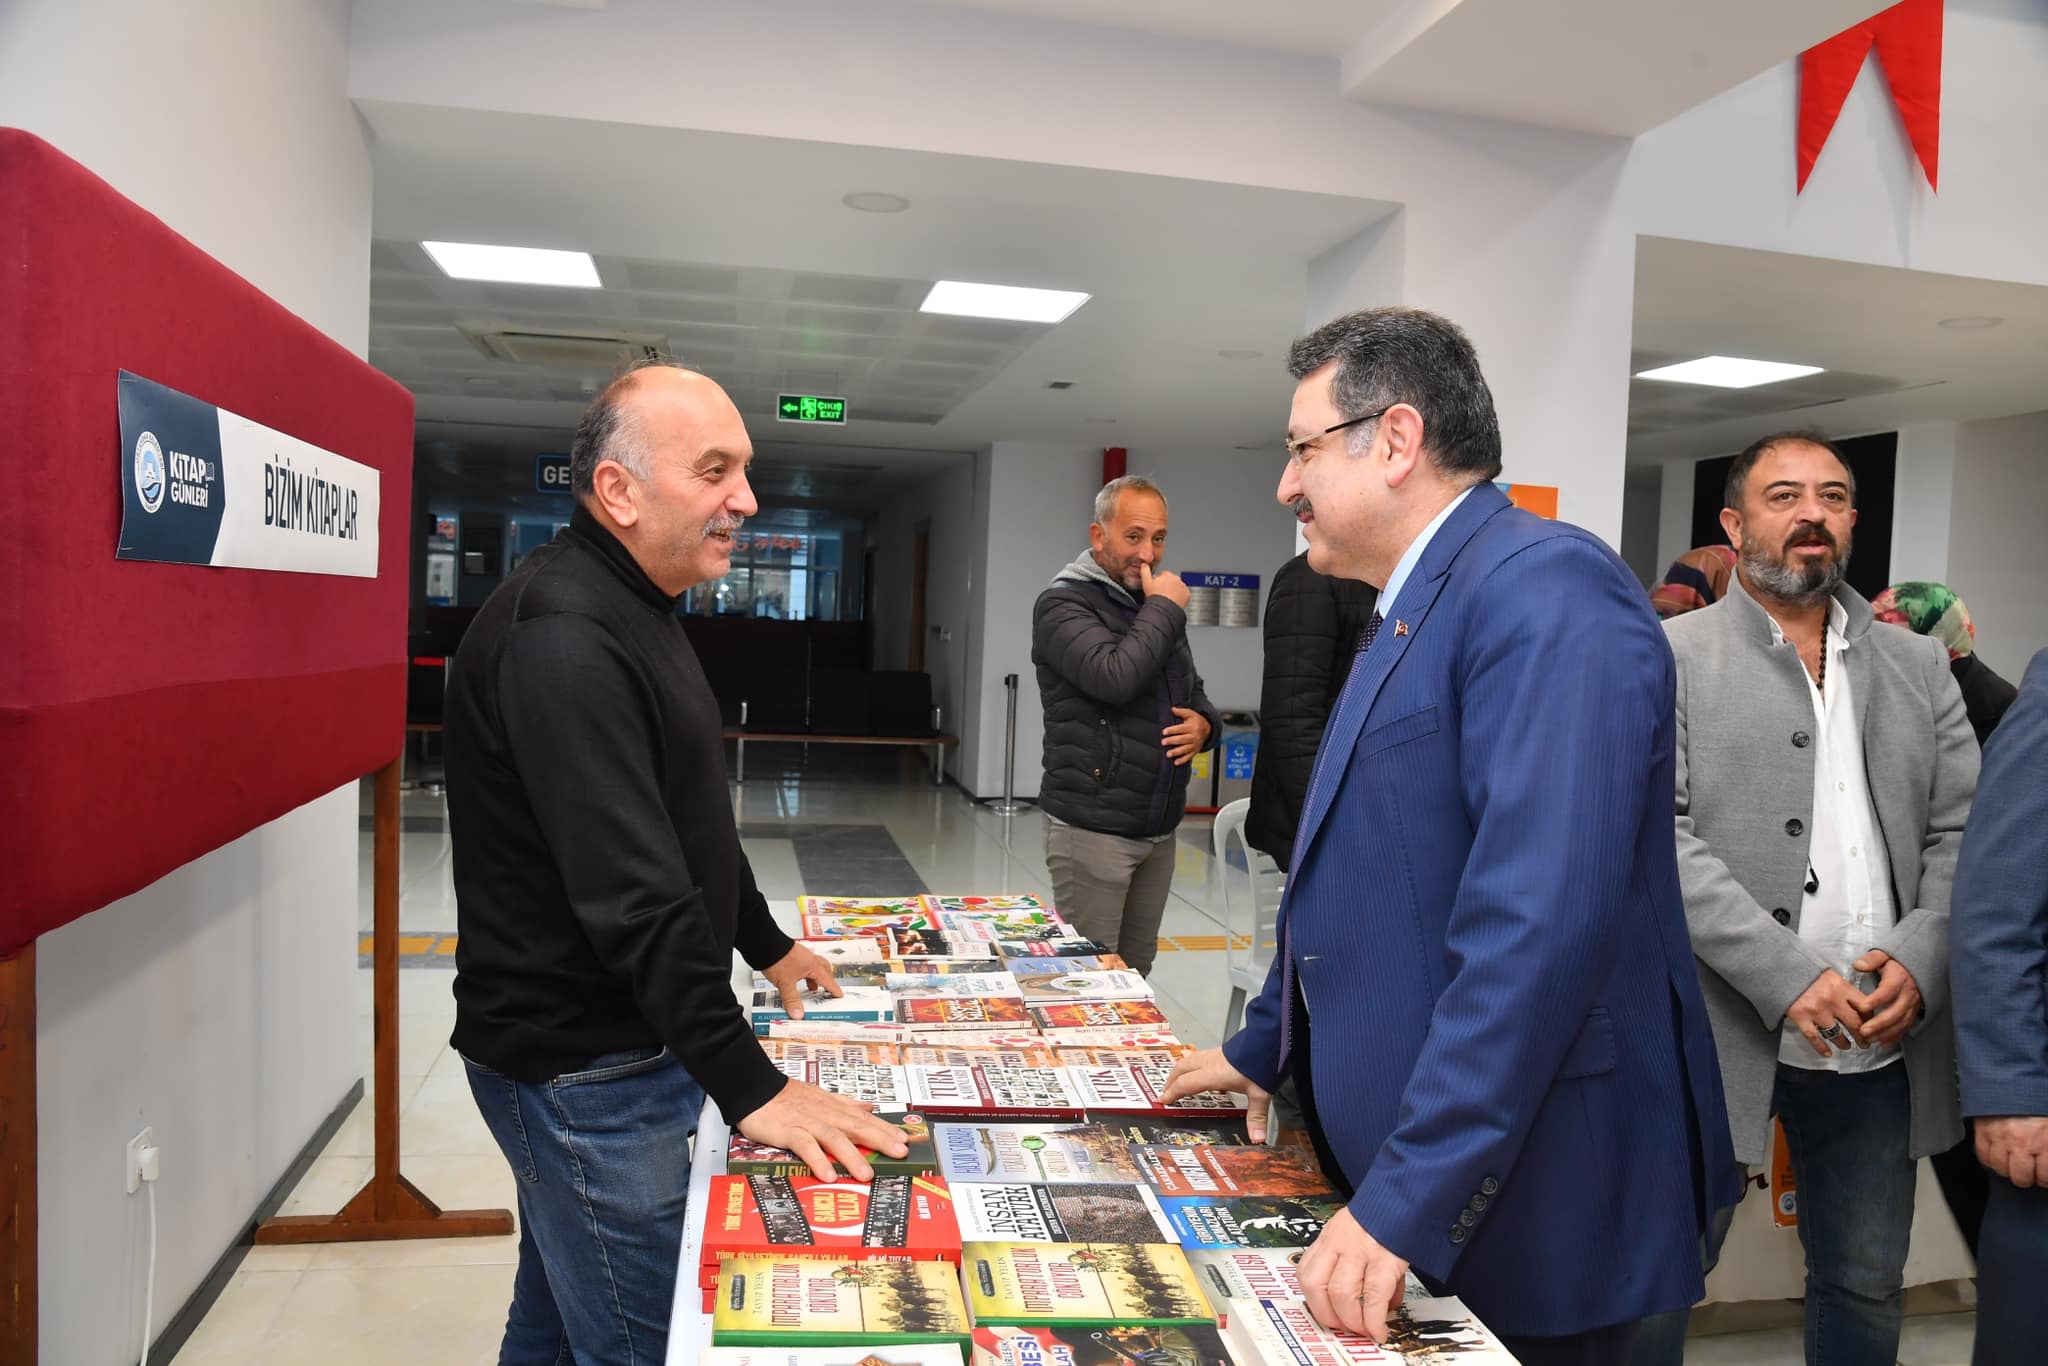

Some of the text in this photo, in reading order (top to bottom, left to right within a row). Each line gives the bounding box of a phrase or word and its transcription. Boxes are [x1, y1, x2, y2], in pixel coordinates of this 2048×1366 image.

[820, 410, 841, 419] EXIT
[169, 450, 206, 483] KİTAP
[543, 465, 571, 485] GE
[170, 481, 209, 508] GÜNLERİ
[264, 453, 358, 541] BİZİM KİTAPLAR
[1204, 575, 1226, 587] KAT
[946, 1128, 977, 1152] SABBAH
[774, 1165, 815, 1177] ALEVİ
[952, 1152, 983, 1174] HASAN
[812, 1192, 836, 1222] SANCILI
[837, 1193, 861, 1221] YILLAR
[980, 1189, 1017, 1233] İNSAN
[1003, 1187, 1047, 1240] ATATÜRK
[1214, 1207, 1245, 1235] ATATÜRK
[722, 1215, 742, 1232] TÜRK
[1197, 1206, 1237, 1244] ÇIKMAZLARI
[1010, 1247, 1054, 1312] İMPARATORLUK
[1047, 1262, 1087, 1298] ÇÖKÜYOR
[767, 1263, 801, 1327] İMPARATORLUK
[805, 1278, 840, 1313] ÇÖKÜYOR
[1281, 1309, 1322, 1343] MESELESİ
